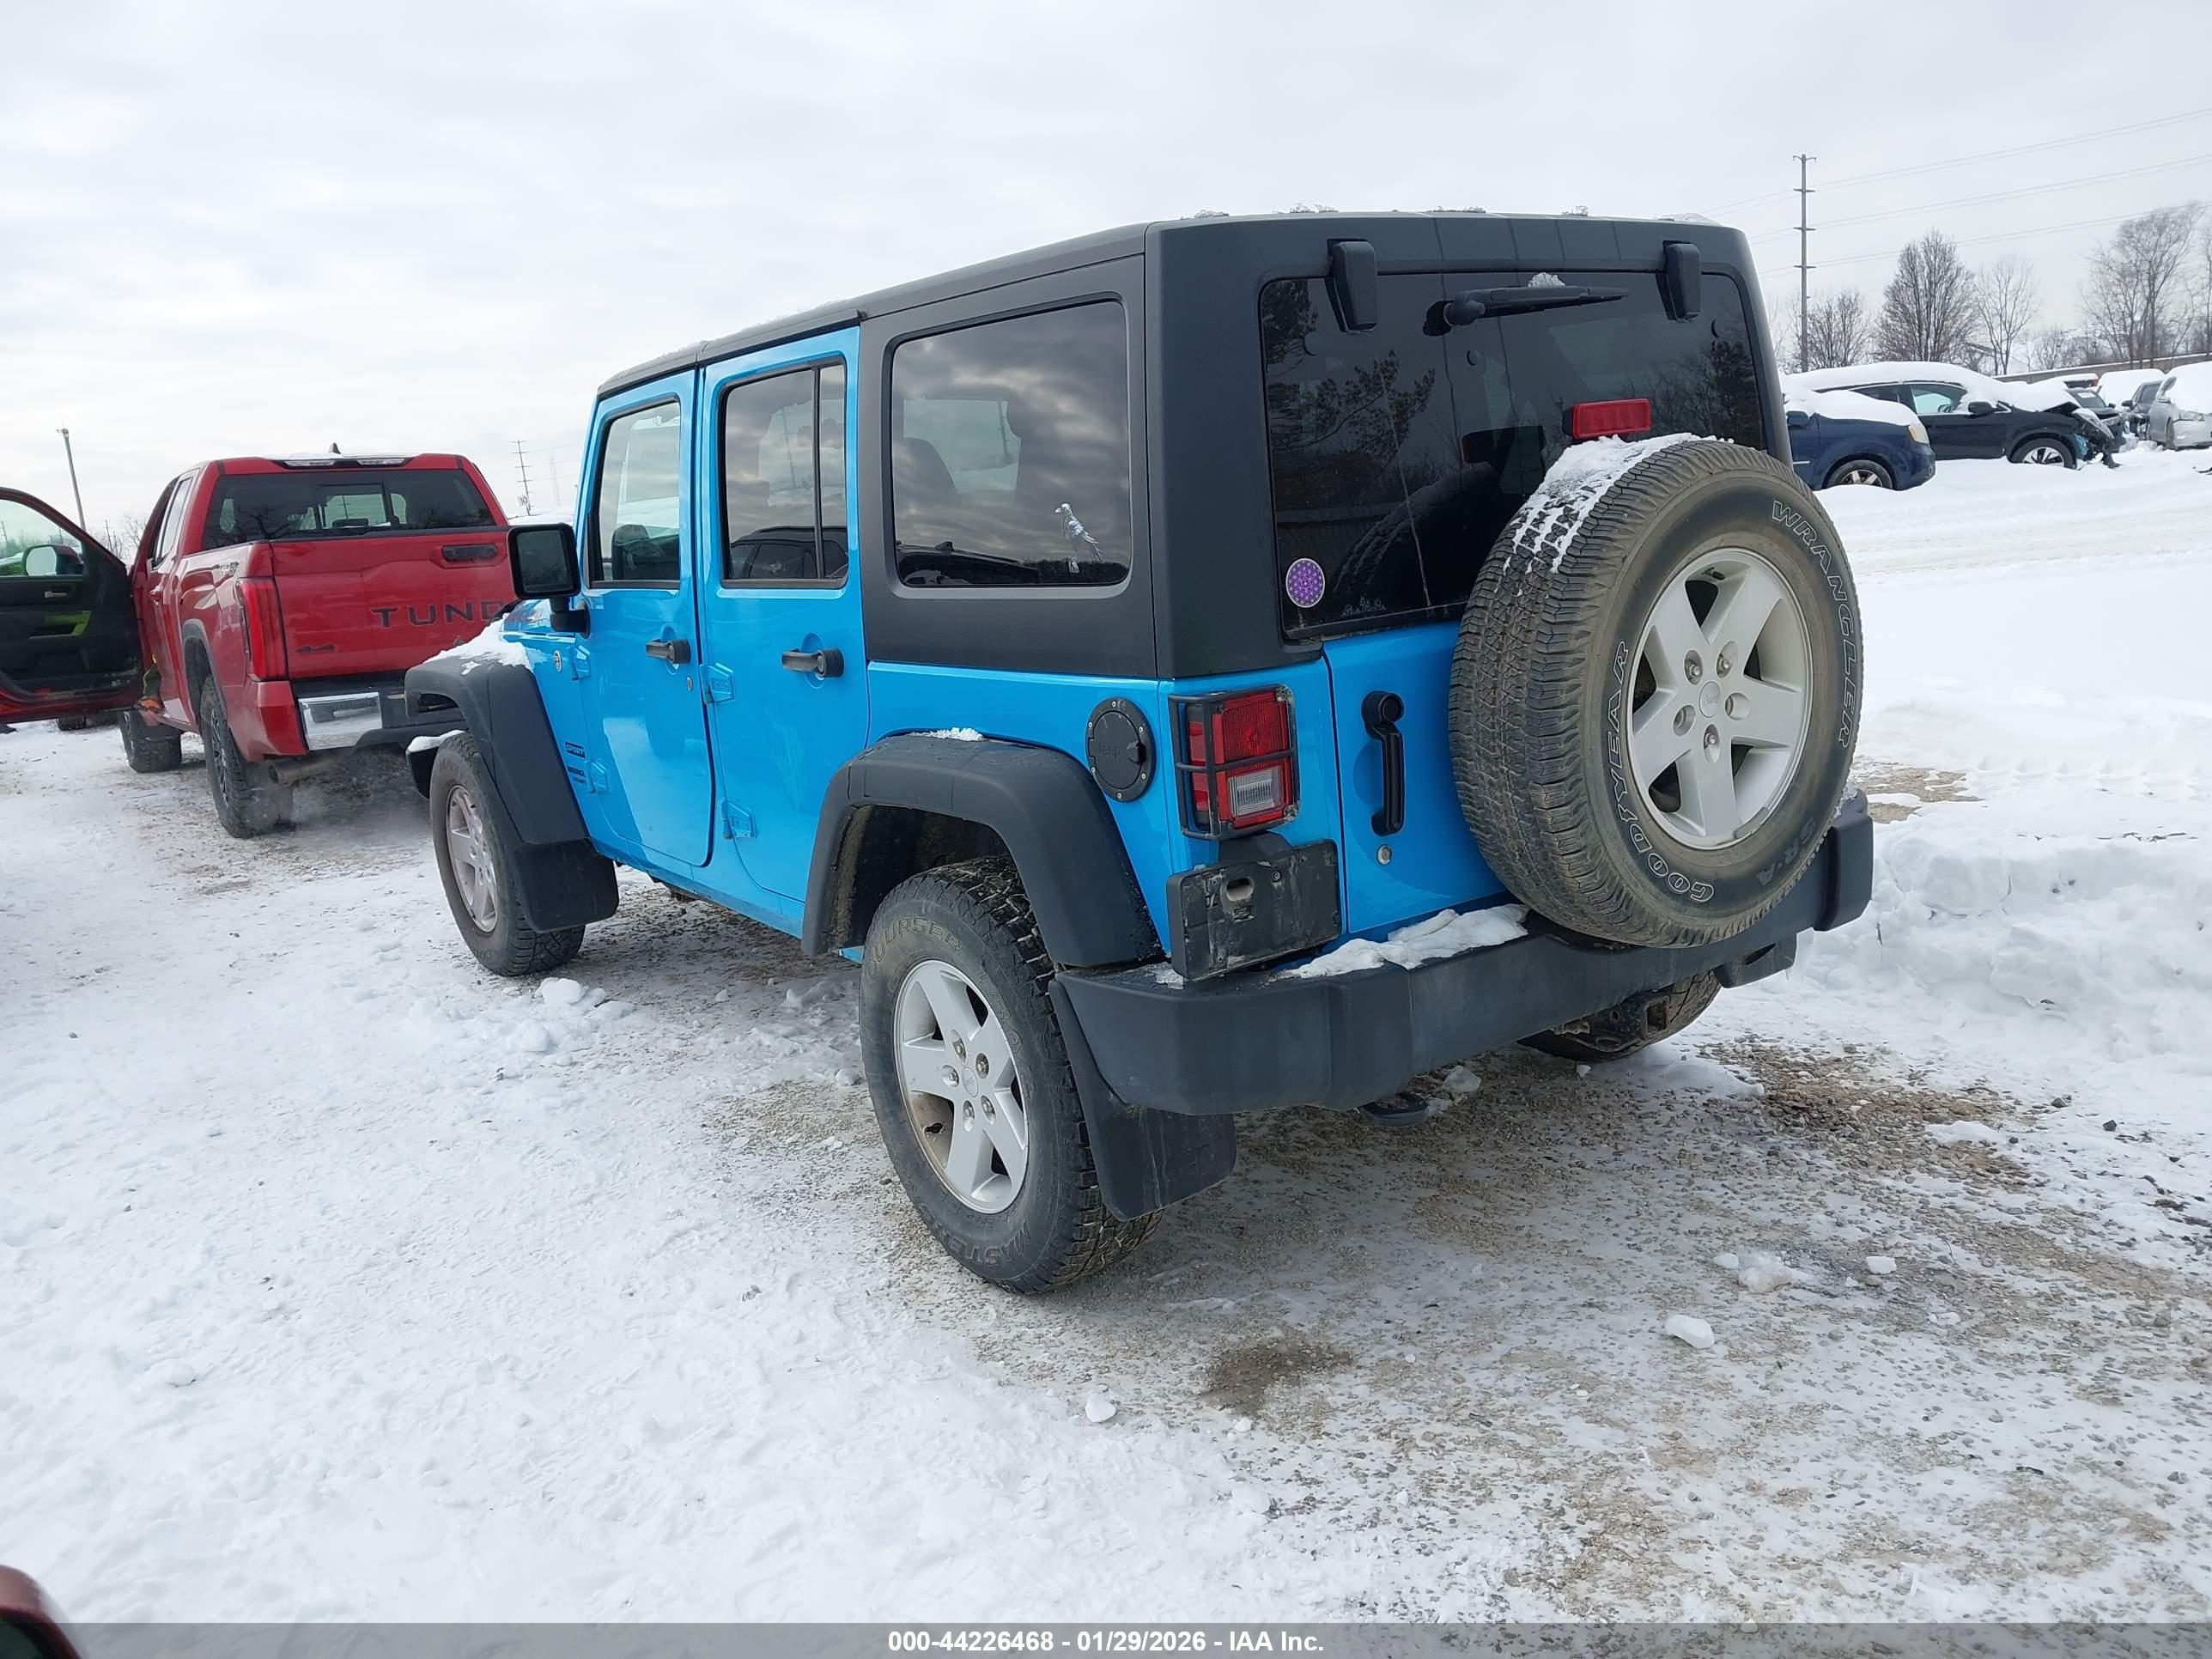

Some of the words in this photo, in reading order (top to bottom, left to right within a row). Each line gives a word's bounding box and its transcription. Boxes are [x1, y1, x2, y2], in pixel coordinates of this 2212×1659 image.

[371, 601, 507, 628] TUND
[1771, 500, 1857, 749] WRANGLER
[1607, 641, 1714, 902] GOODYEAR
